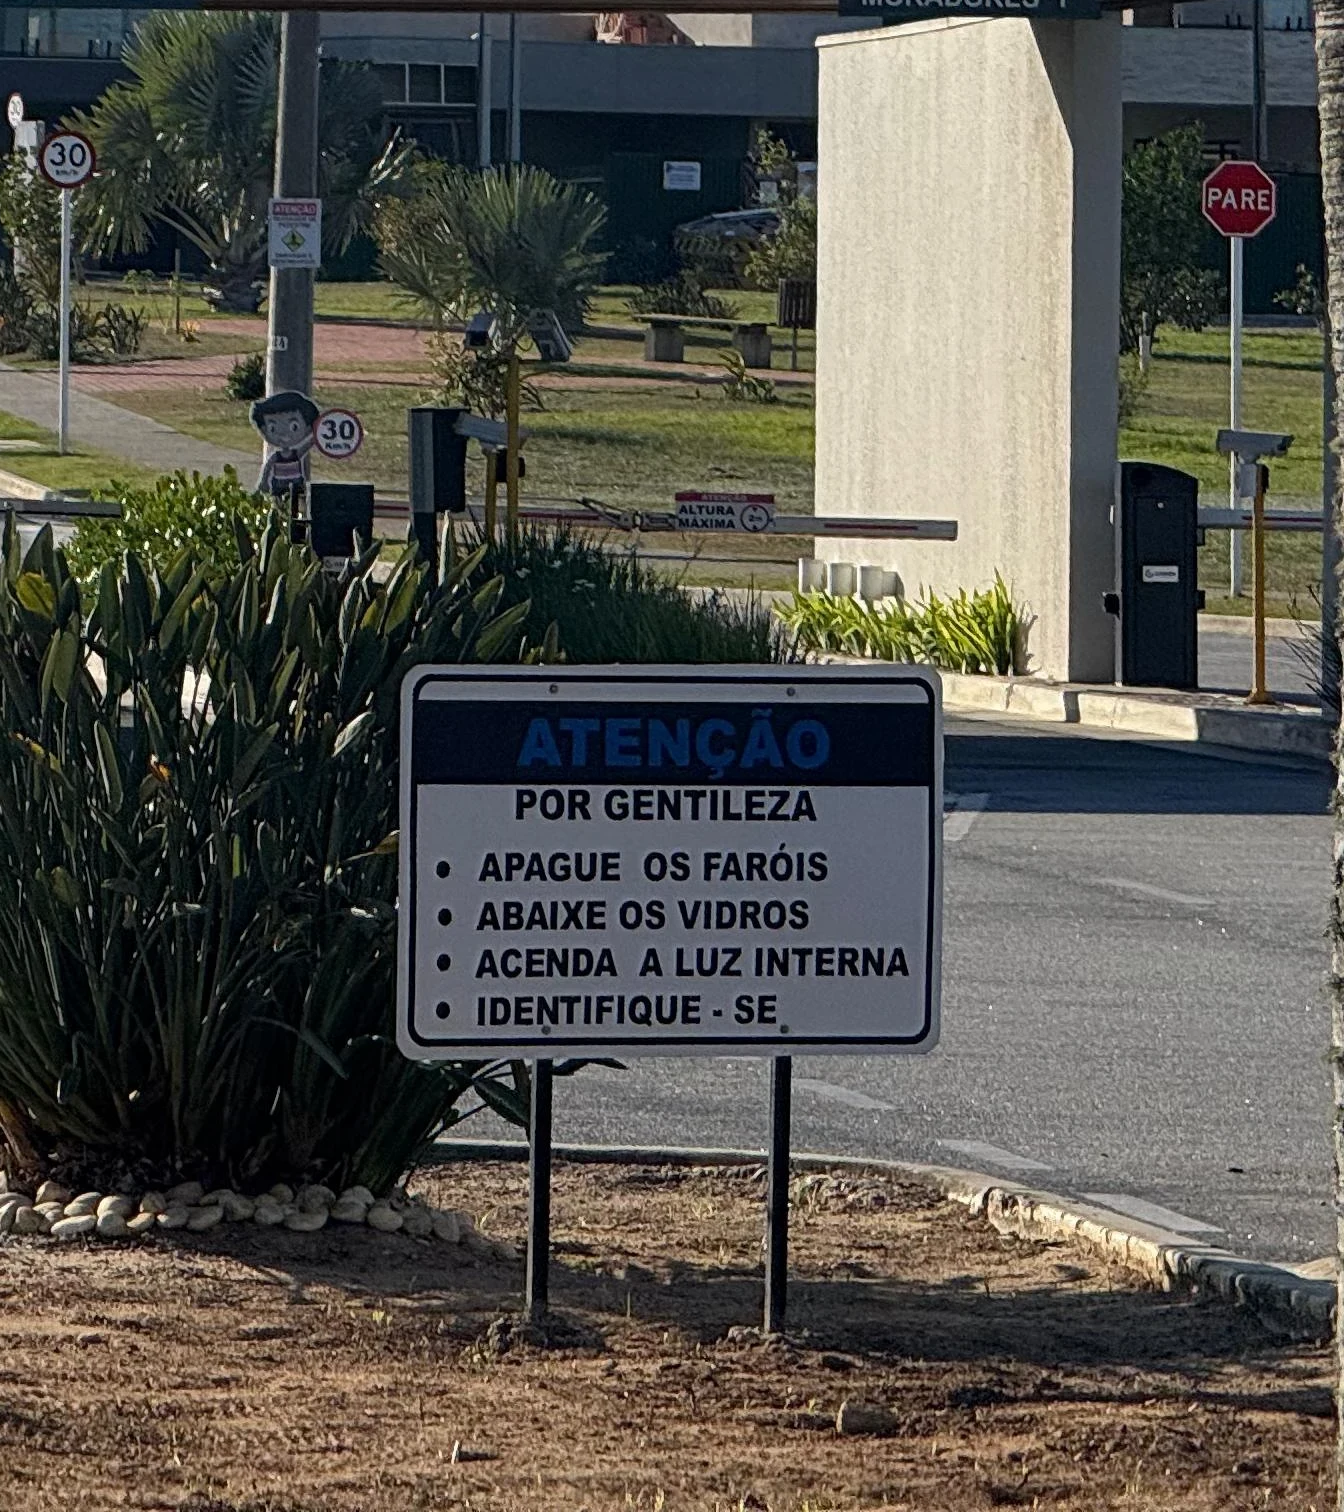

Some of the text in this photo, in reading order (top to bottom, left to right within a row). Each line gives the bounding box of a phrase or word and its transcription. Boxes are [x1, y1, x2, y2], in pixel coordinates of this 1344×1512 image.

[50, 142, 86, 167] 30
[1207, 188, 1271, 211] PARE
[321, 419, 355, 440] 30
[678, 516, 736, 529] MÁXIMA
[679, 504, 736, 516] ALTURA
[516, 708, 831, 780] ATENÇÃO
[515, 789, 817, 821] POR GENTILEZA
[478, 843, 829, 882] APAGUE OS FARÓIS
[476, 900, 810, 931] ABAIXE OS VIDROS
[475, 947, 910, 979] ACENDA A LUZ INTERNA
[477, 995, 702, 1027] IDENTIFIQUE
[734, 994, 777, 1025] SE
